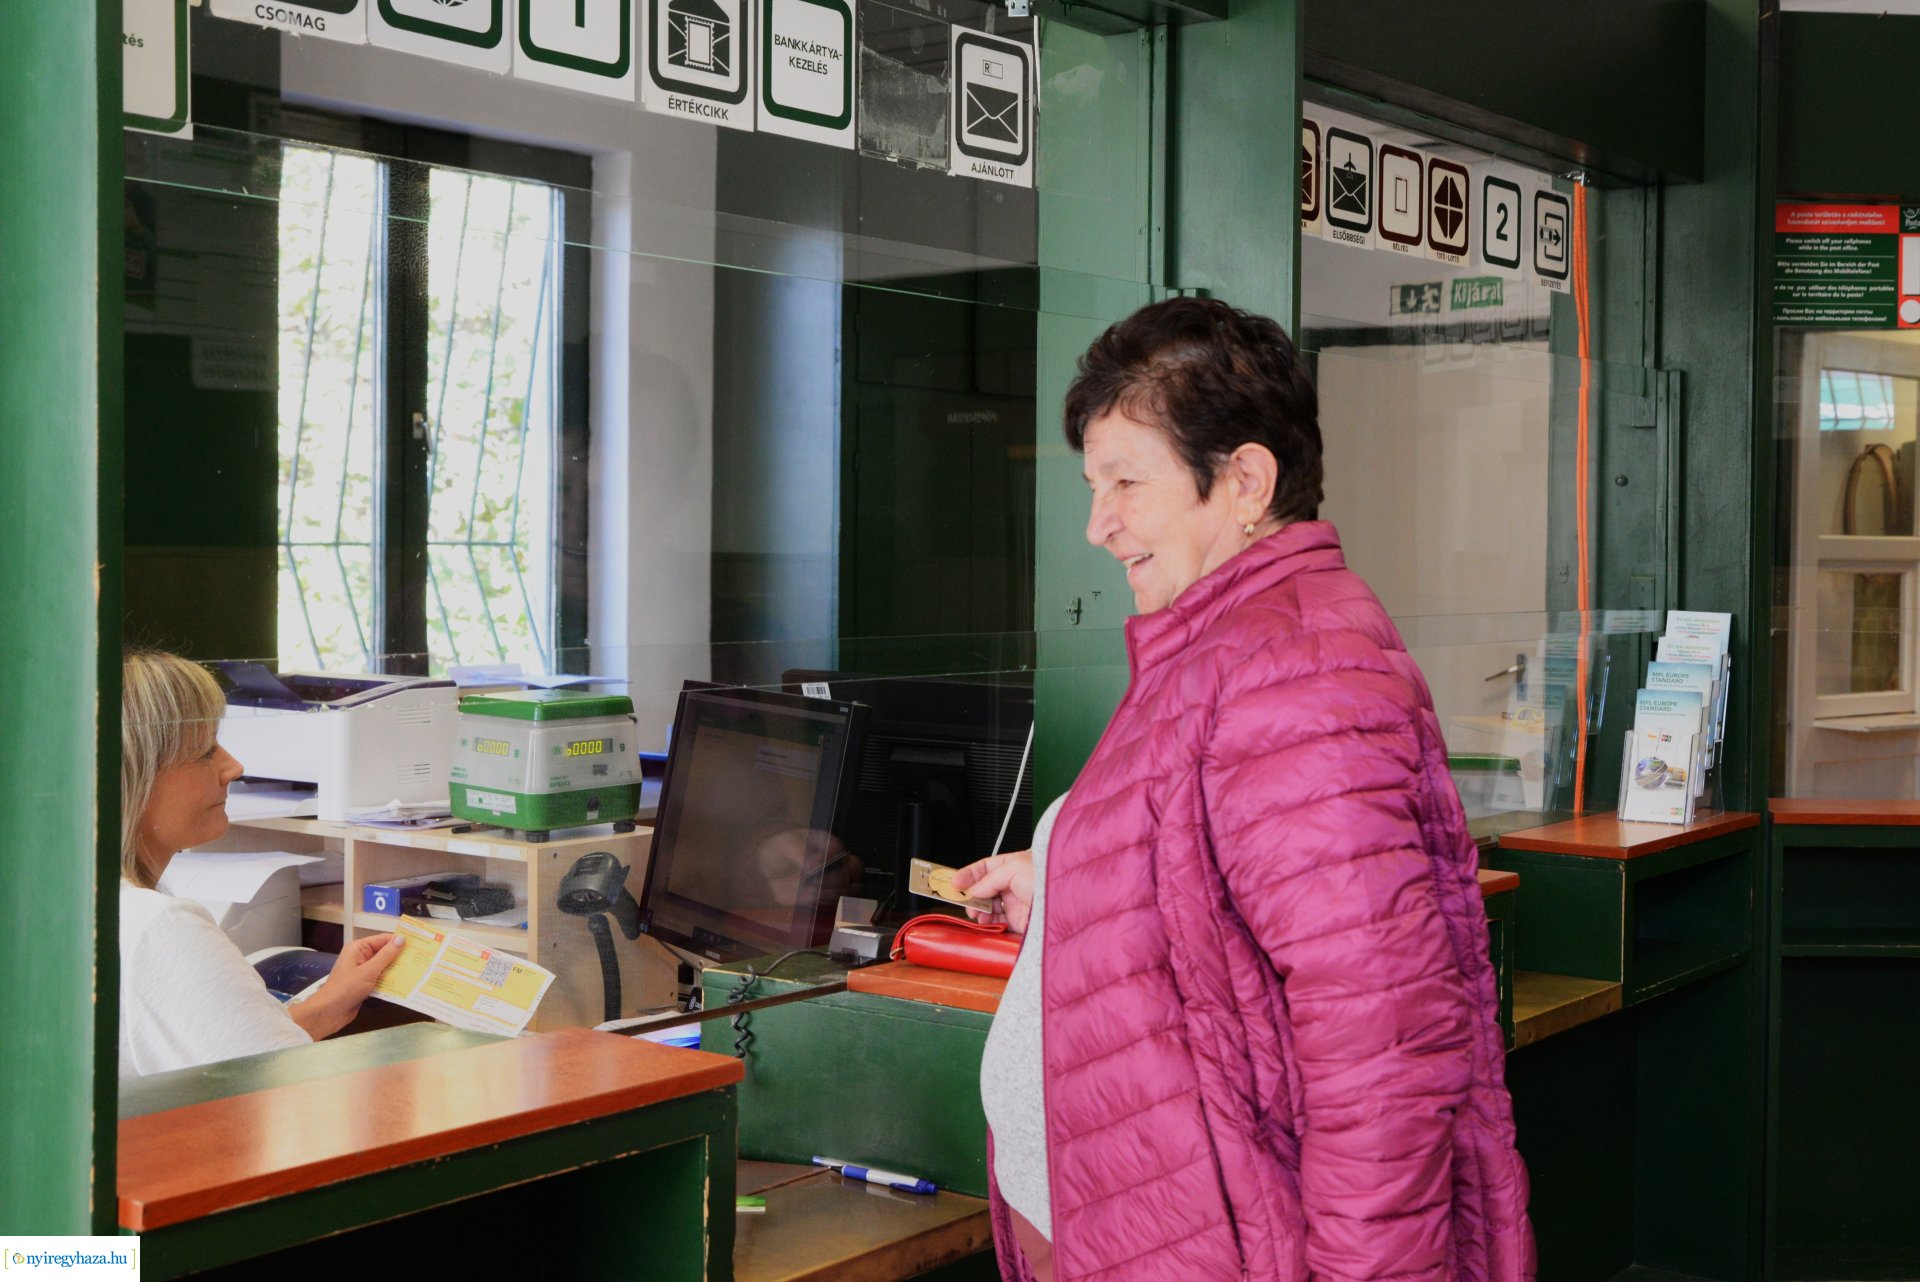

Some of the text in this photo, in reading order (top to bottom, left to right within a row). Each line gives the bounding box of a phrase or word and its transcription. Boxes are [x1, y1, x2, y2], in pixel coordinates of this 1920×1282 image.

[255, 5, 326, 31] CSOMAG
[774, 34, 843, 61] BANKKÁRTYA-
[789, 55, 828, 75] KEZELÉS
[984, 63, 990, 74] R
[668, 95, 729, 121] ÉRTÉKCIKK
[971, 162, 1014, 180] AJÁNLOTT
[1496, 202, 1508, 242] 2
[1333, 230, 1365, 245] ELSŐBBSÉGI
[512, 966, 523, 975] FM
